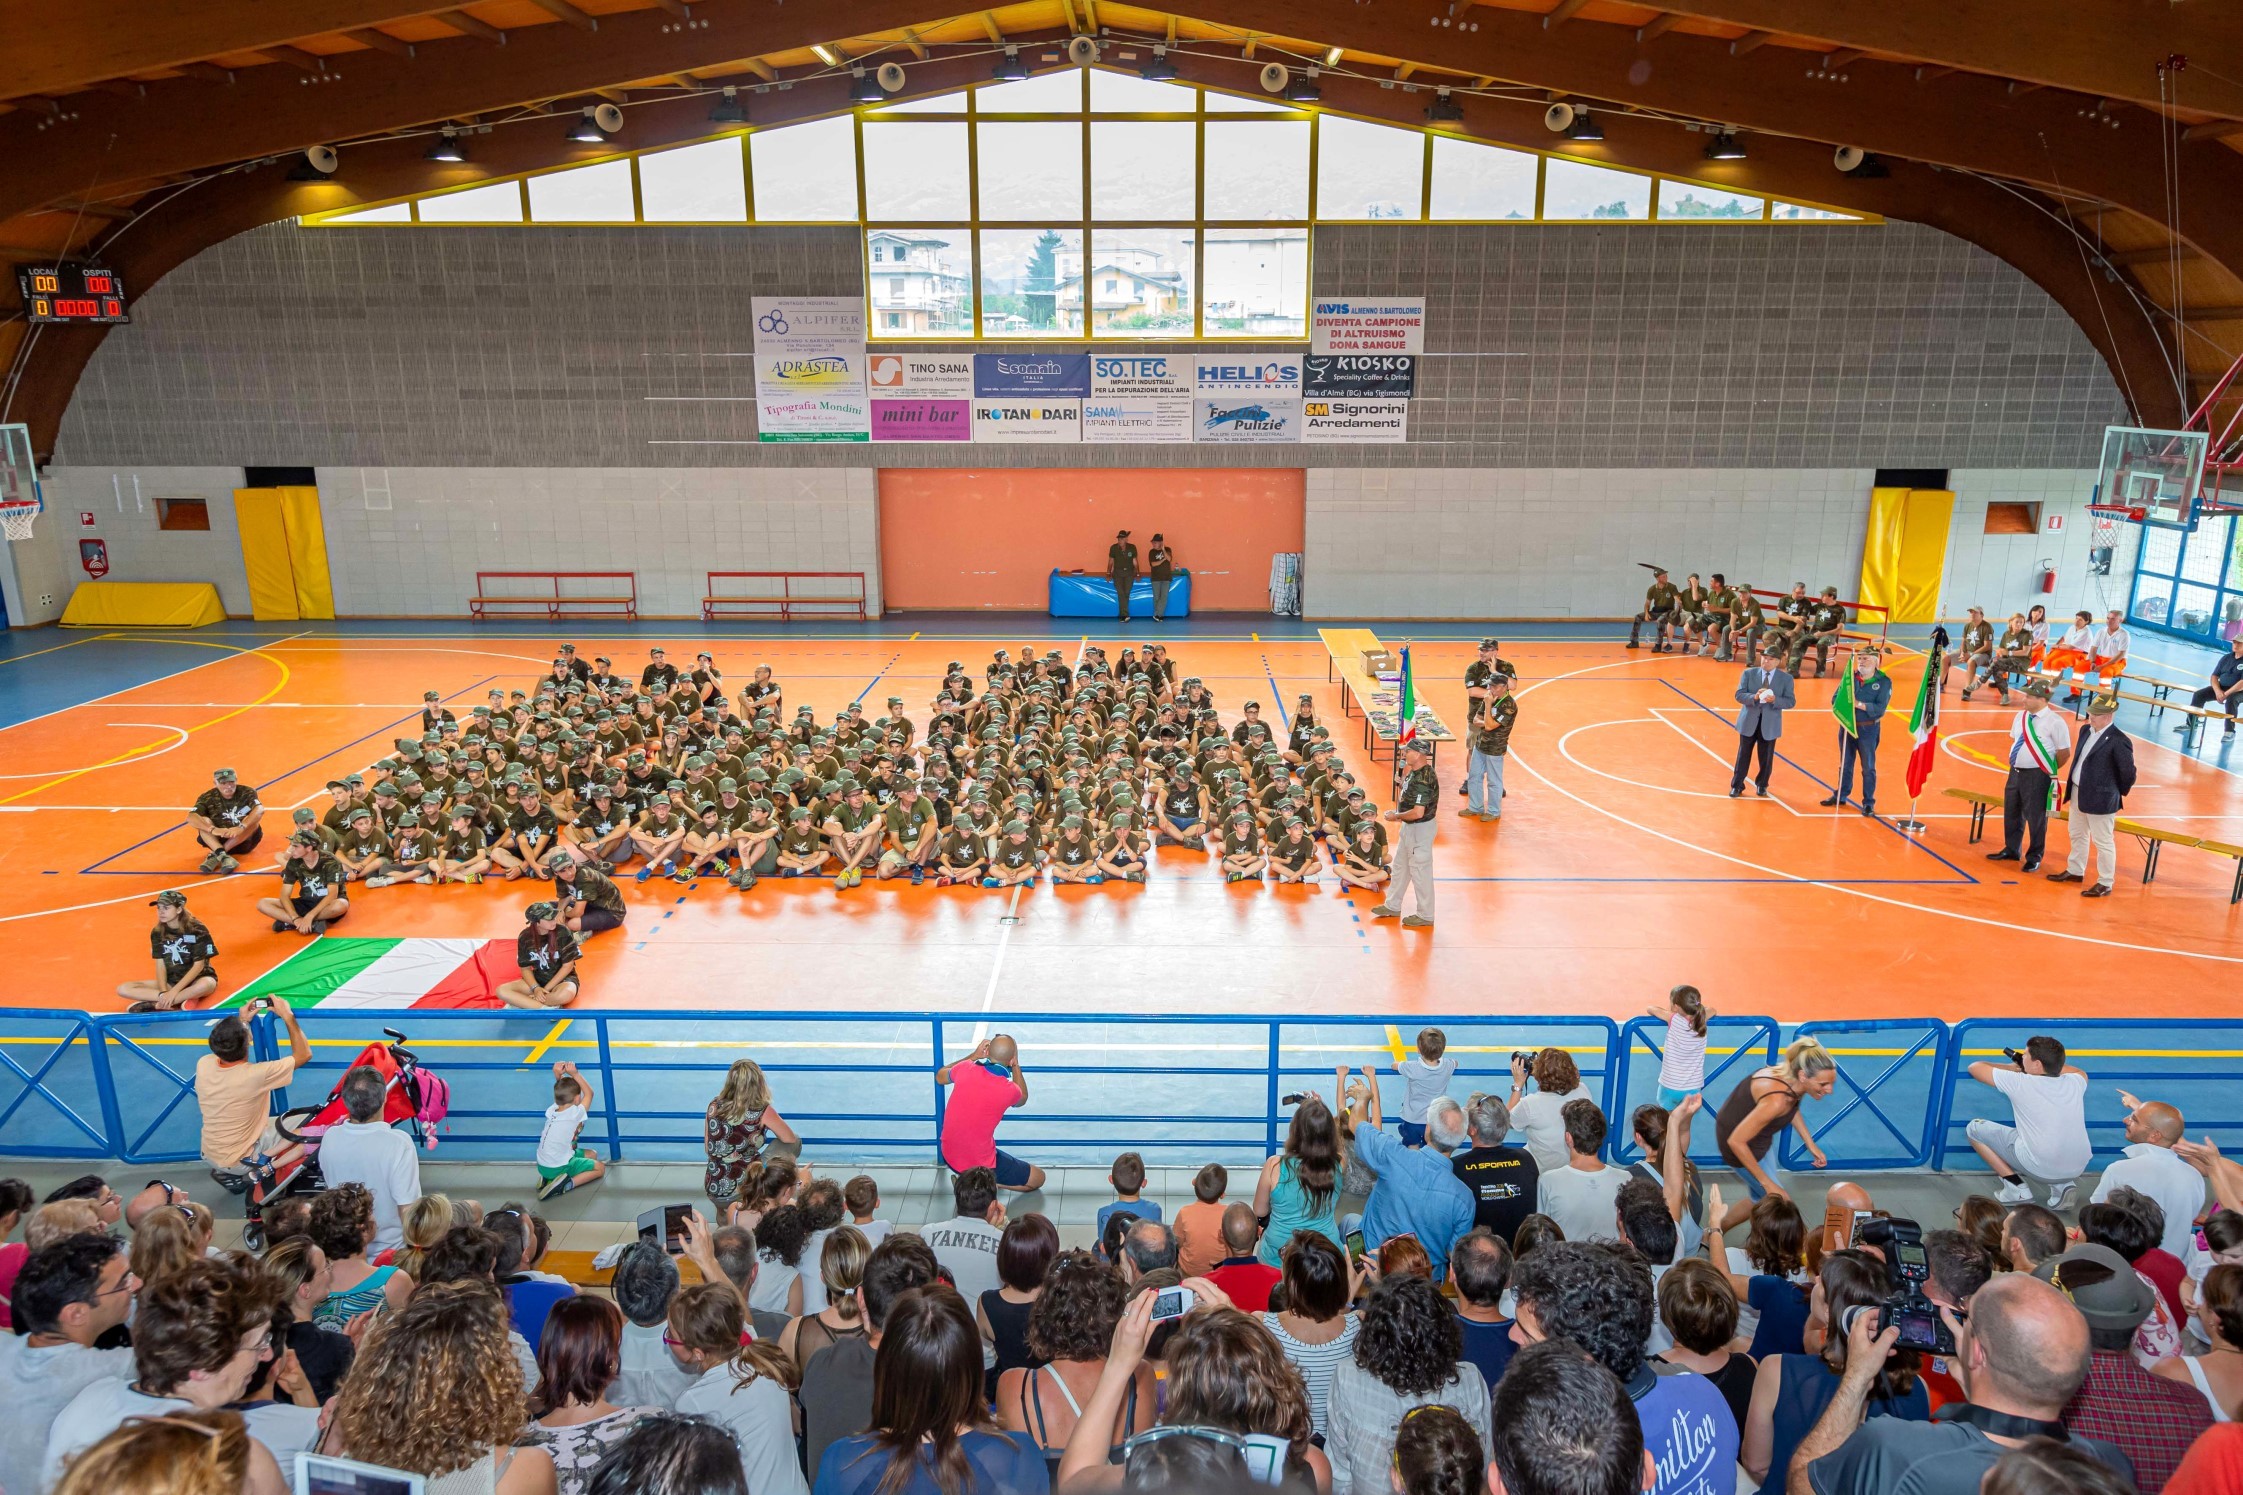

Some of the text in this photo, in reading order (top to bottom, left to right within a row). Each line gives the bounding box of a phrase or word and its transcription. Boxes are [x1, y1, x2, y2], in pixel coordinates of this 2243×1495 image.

[28, 268, 58, 276] LOCALI
[82, 269, 112, 277] OSPITI
[36, 276, 57, 292] 00
[89, 277, 110, 292] 00
[1316, 304, 1350, 315] AVIS
[792, 315, 860, 325] ALPIFER
[1316, 319, 1420, 327] DIVENTA CAMPIONE
[1331, 330, 1405, 338] DI ALTRUISMO
[1330, 341, 1406, 349] DONA SANGUE
[772, 361, 850, 373] ADRASTEA
[910, 364, 969, 373] TINO SANA
[1009, 360, 1062, 375] somain
[1096, 358, 1167, 378] SO.TEC
[1337, 356, 1410, 371] KIOSKO
[1198, 363, 1298, 383] HELIOS
[764, 401, 862, 416] Tipografia Mondini
[882, 405, 959, 422] mini bar
[1085, 406, 1116, 418] SANA
[1210, 407, 1262, 418] Faccini
[1305, 403, 1329, 416] SM
[1332, 403, 1405, 417] Signorini
[1234, 419, 1283, 430] Pulizie
[1308, 419, 1400, 428] Arredamenti
[1479, 1160, 1521, 1169] SPORTIVA
[930, 1229, 1001, 1256] YANKEE
[1645, 1408, 1716, 1495] milton
